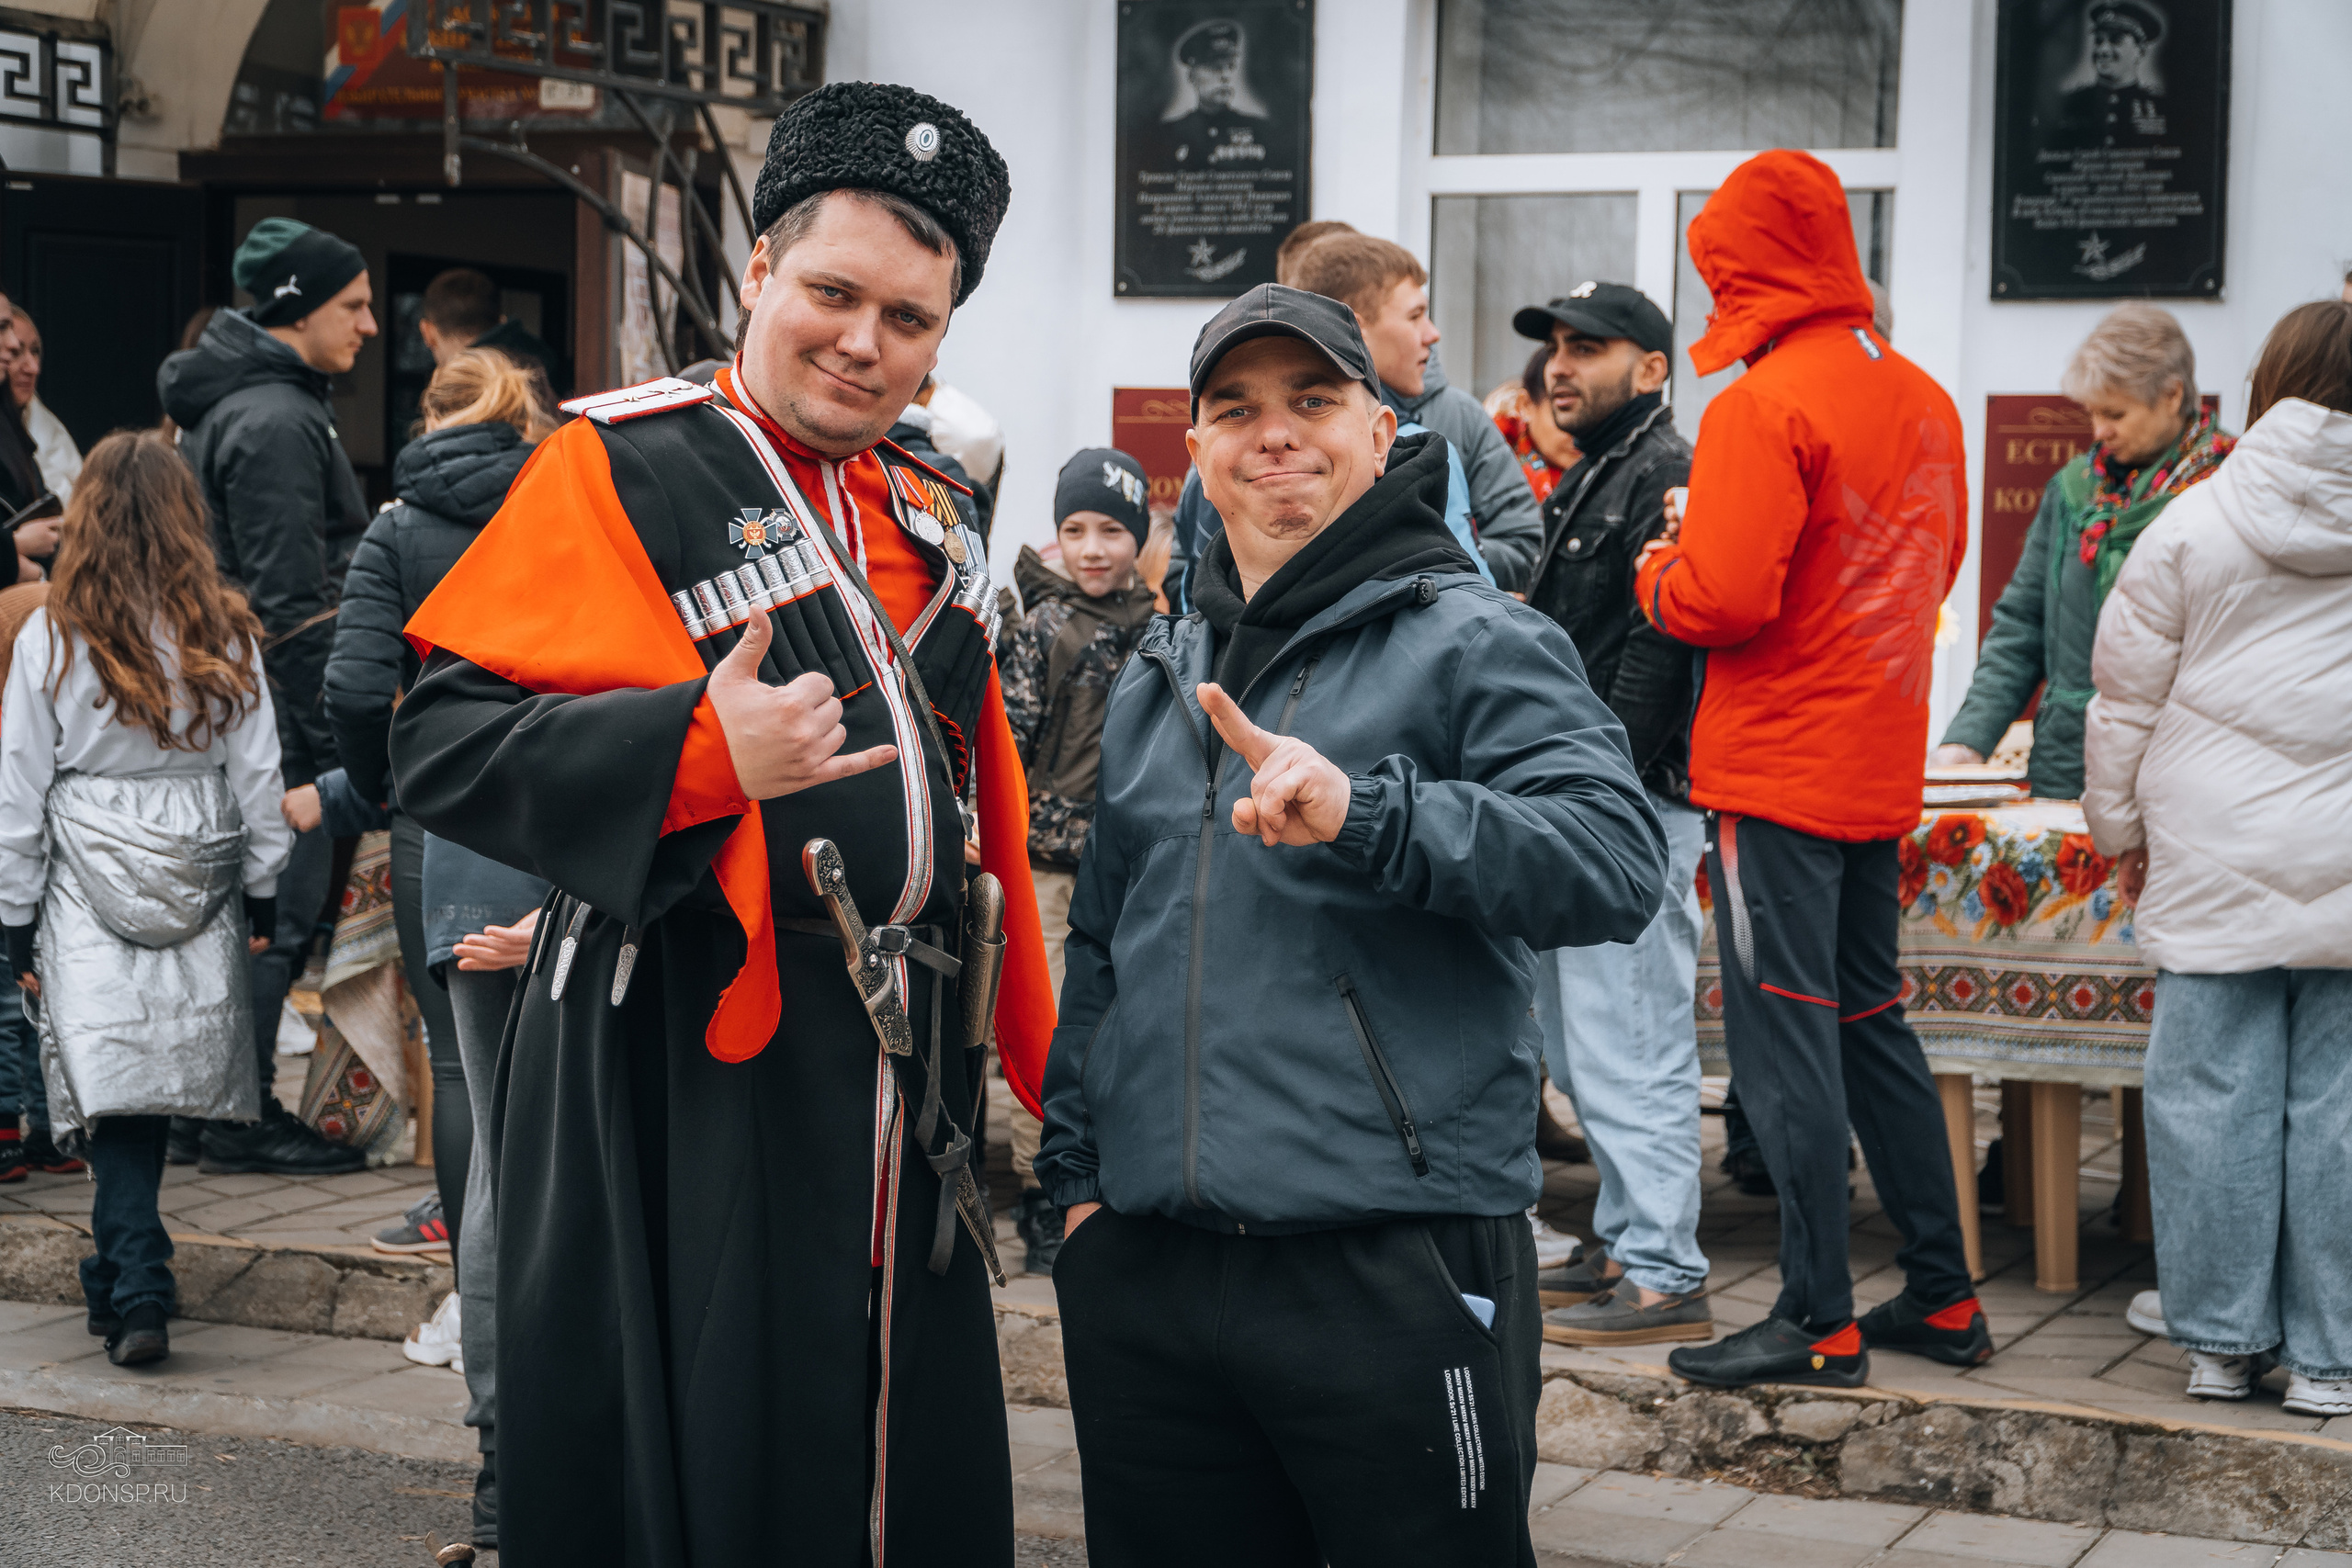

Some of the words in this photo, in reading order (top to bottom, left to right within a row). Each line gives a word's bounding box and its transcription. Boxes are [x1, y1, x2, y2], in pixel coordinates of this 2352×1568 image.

[1444, 1369, 1454, 1402] LOOKBOOK
[1454, 1432, 1464, 1467] COLLECTION
[1463, 1366, 1473, 1394] LOOKBOOK
[1473, 1424, 1482, 1454] COLLECTION
